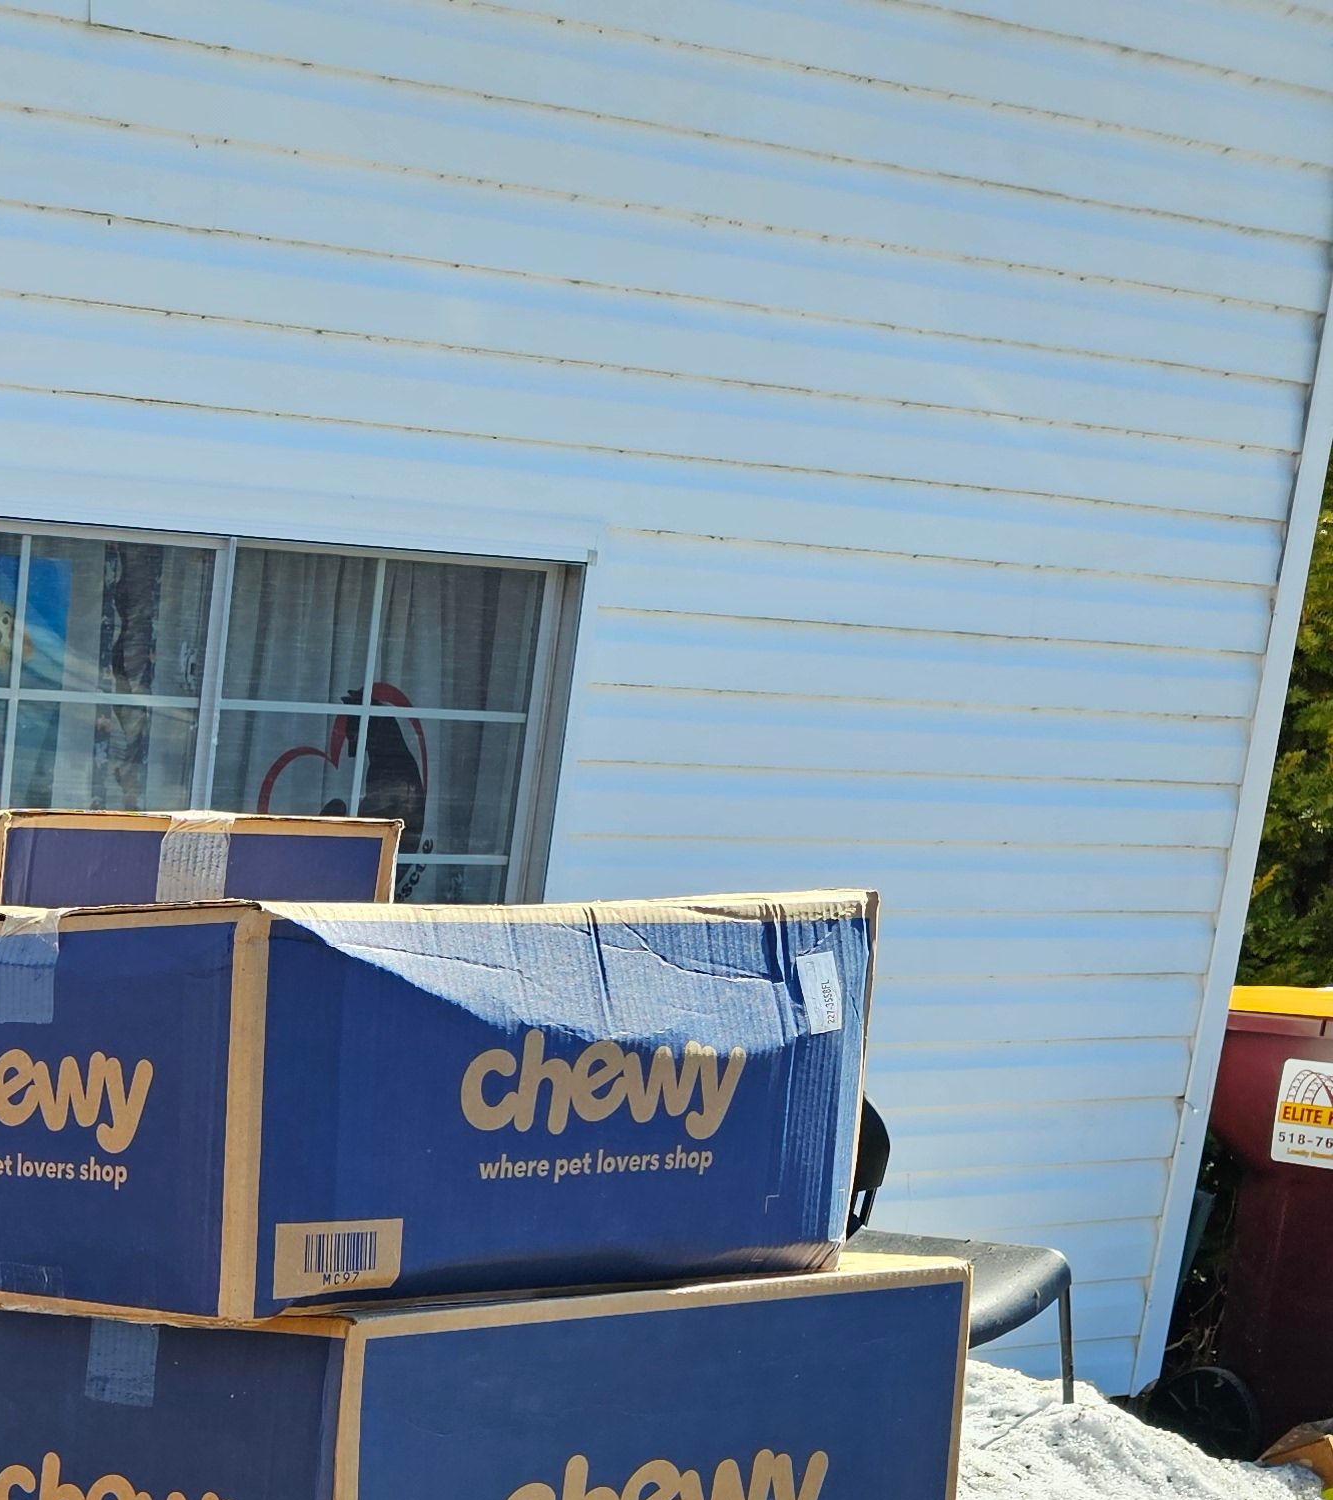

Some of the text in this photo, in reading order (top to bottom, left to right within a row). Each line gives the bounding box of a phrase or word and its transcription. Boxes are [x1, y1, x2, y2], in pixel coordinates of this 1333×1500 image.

[461, 1029, 747, 1140] chewy
[1282, 1105, 1323, 1125] ELITE
[17, 1153, 75, 1180] lovers
[80, 1156, 128, 1190] shop
[479, 1145, 713, 1183] where pet lovers shop
[322, 1272, 360, 1287] MC97
